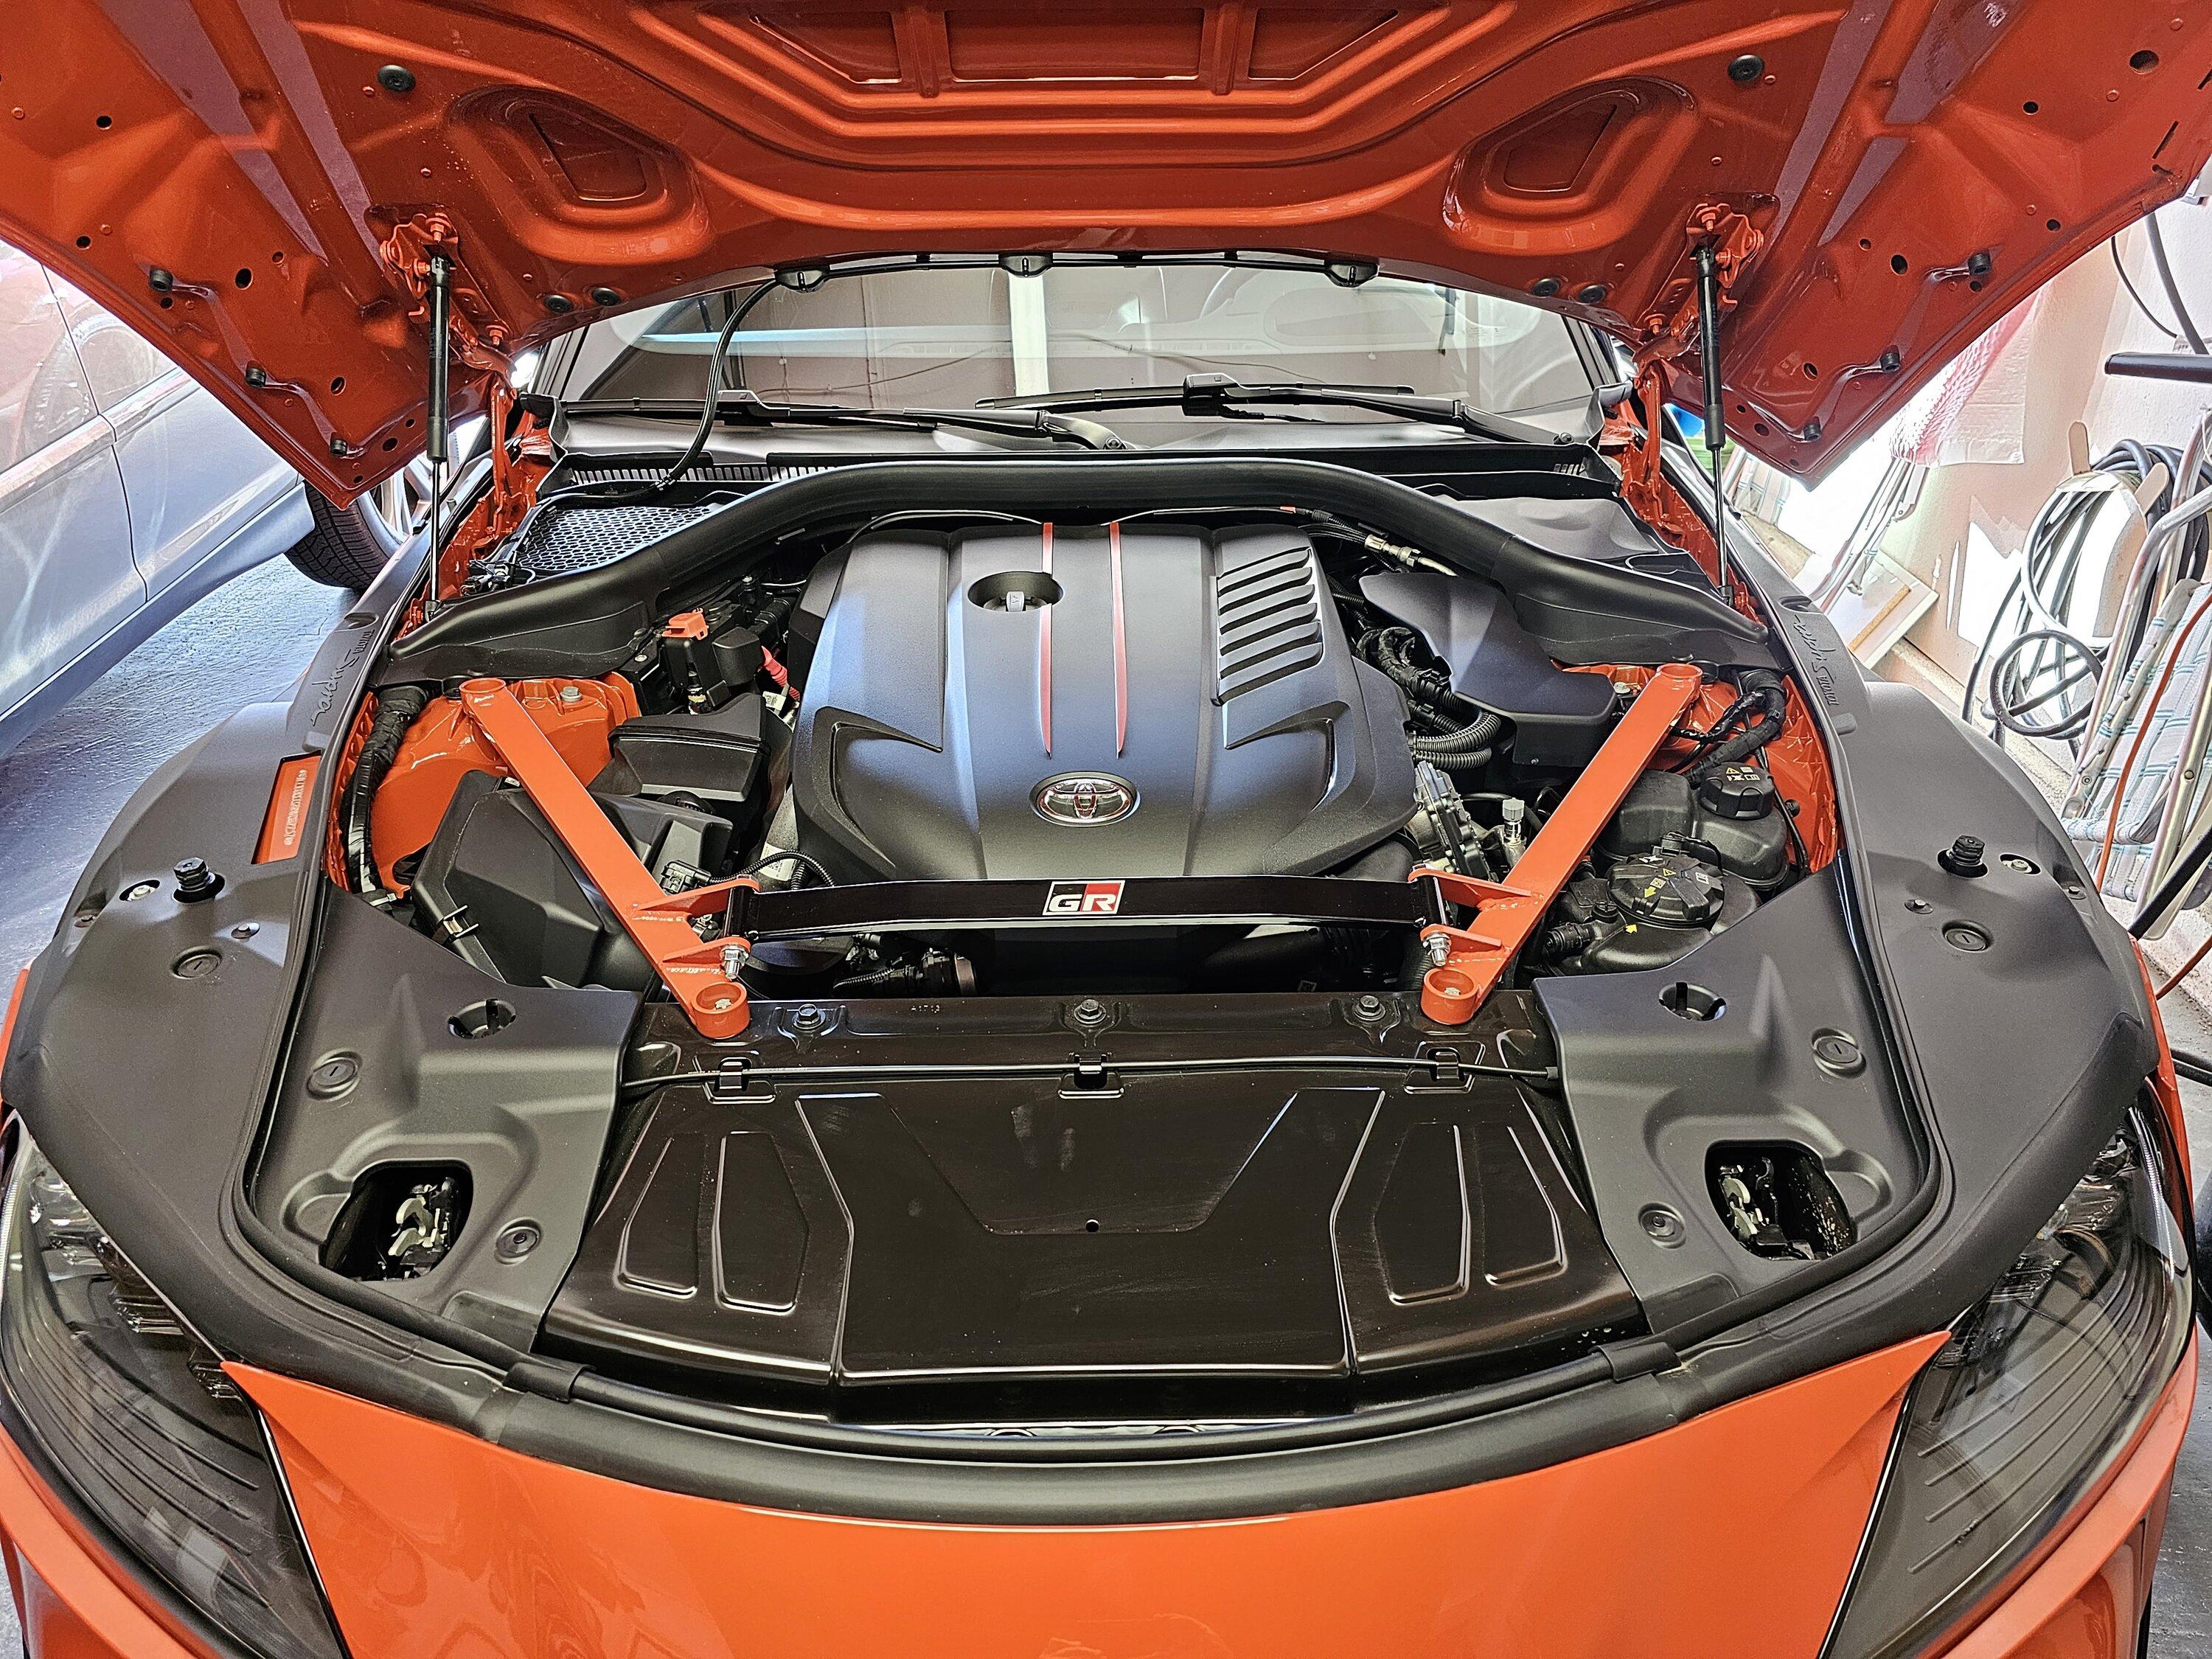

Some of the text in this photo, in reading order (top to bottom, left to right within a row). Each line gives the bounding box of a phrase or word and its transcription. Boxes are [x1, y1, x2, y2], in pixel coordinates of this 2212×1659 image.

[352, 629, 376, 655] TOYOTA
[1816, 676, 1840, 706] TOYOTA
[1048, 894, 1117, 912] GR
